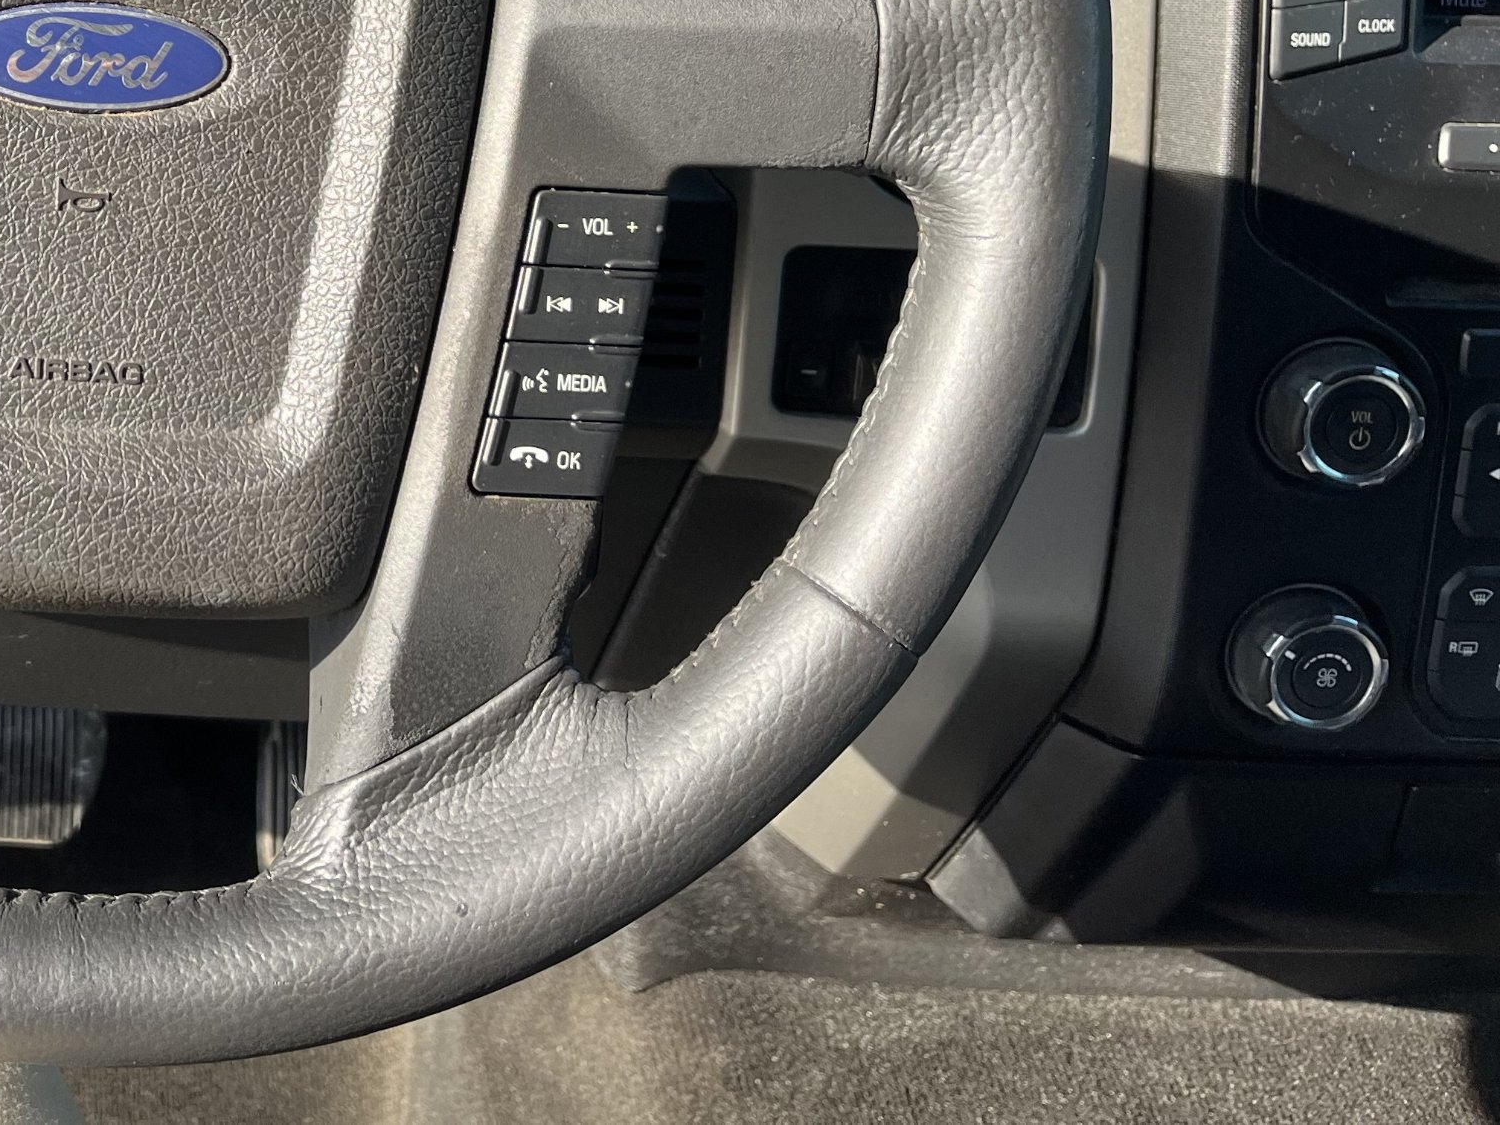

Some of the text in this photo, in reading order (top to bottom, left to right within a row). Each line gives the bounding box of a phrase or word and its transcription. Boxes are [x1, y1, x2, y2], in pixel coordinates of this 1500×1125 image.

[1358, 18, 1396, 34] CLOCK
[1290, 31, 1331, 47] SOUND
[7, 16, 173, 90] Ford
[582, 218, 613, 236] VOL
[11, 356, 146, 385] AIRBAG
[557, 373, 607, 393] MEDIA
[1351, 410, 1374, 424] VOL
[556, 451, 581, 470] OK
